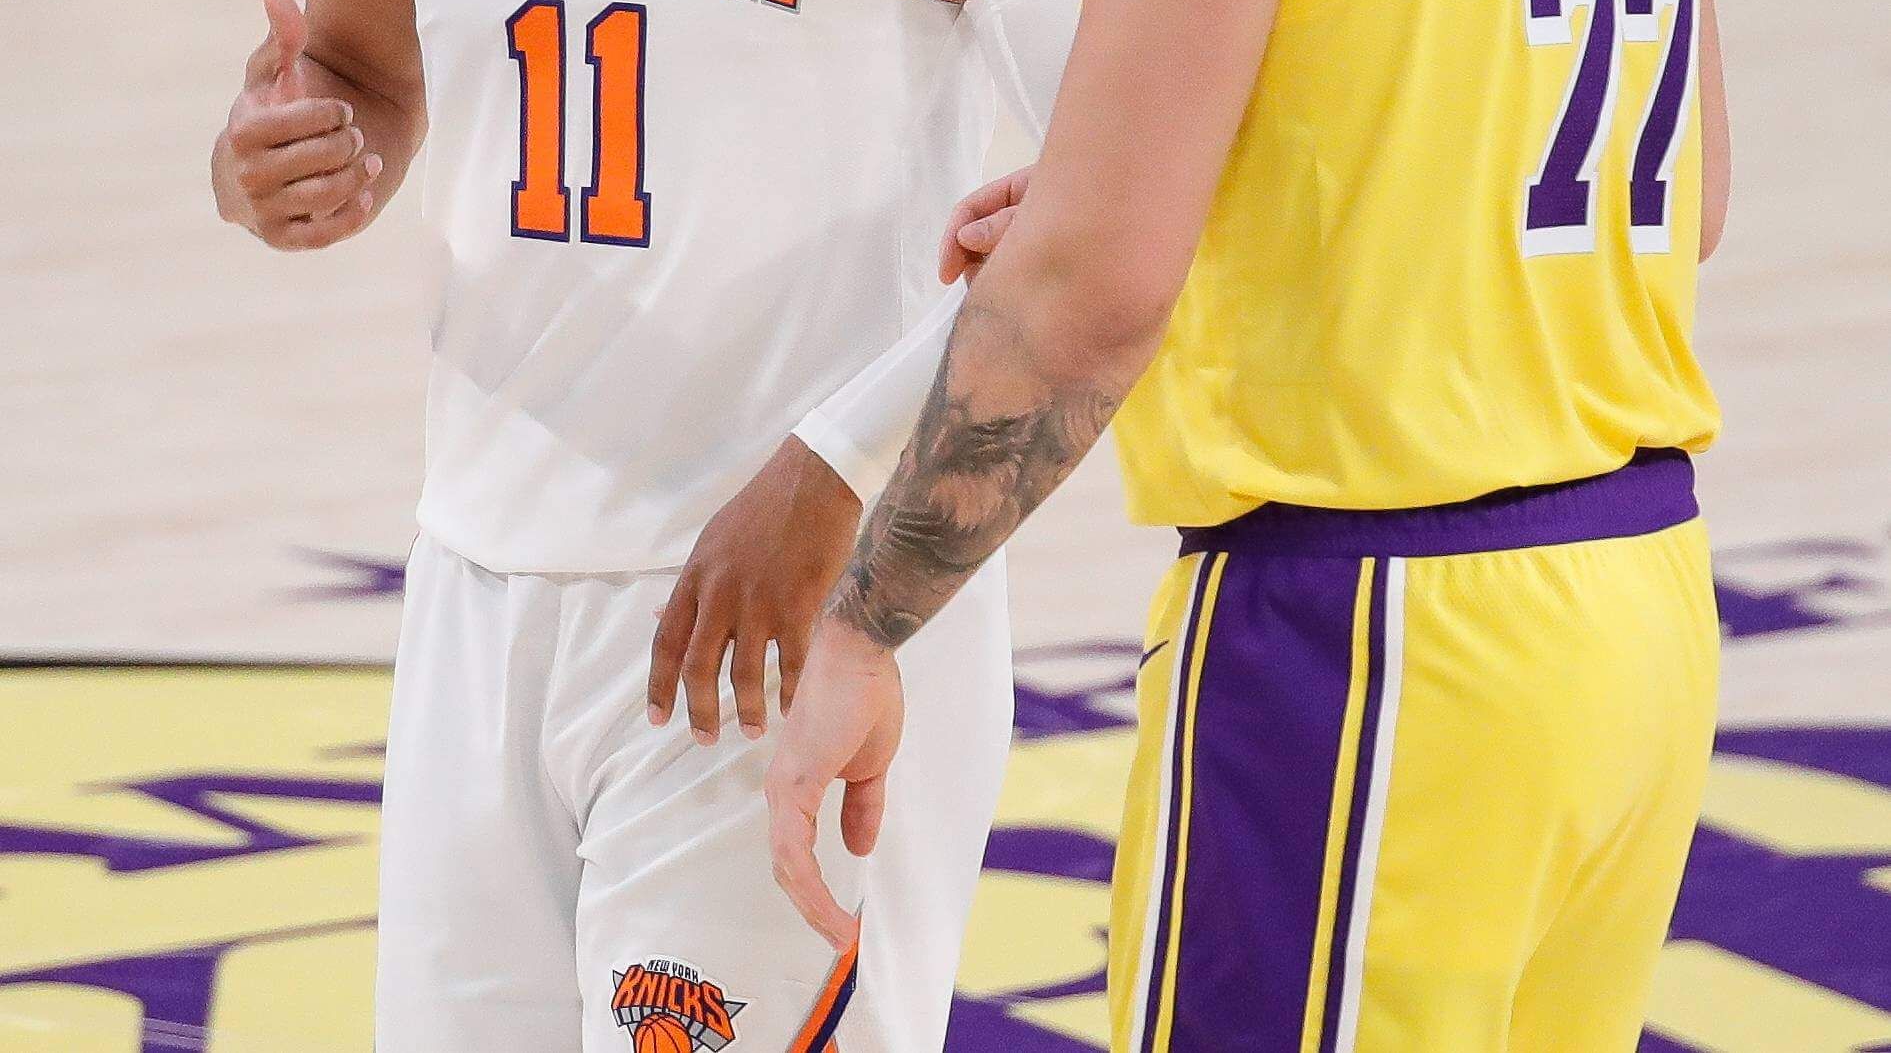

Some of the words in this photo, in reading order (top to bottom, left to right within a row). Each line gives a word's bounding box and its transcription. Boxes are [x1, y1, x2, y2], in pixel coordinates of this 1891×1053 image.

[647, 959, 670, 973] NEW
[672, 961, 699, 983] YORK
[611, 963, 735, 1041] KNICKS
